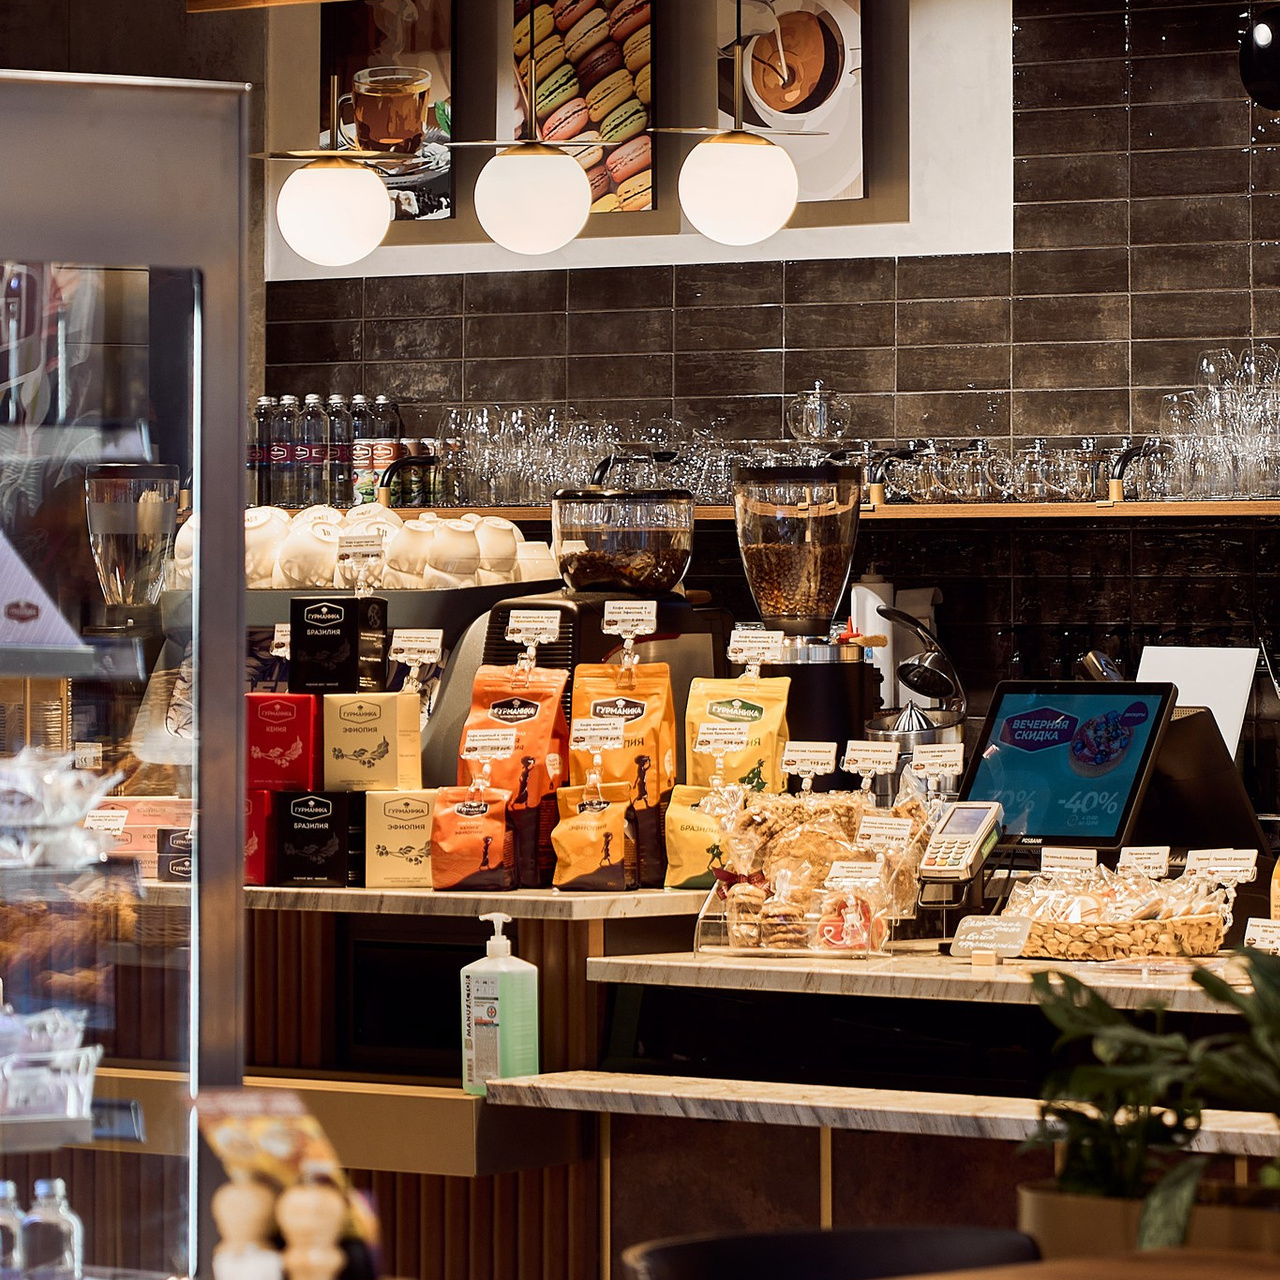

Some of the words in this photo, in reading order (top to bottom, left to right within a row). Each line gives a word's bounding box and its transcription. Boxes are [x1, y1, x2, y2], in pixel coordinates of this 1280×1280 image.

[307, 612, 340, 620] ГУРМАНИКА
[343, 710, 377, 718] ГУРМАНИКА
[596, 705, 642, 716] ГУРМАНИКА
[711, 705, 760, 718] ГУРМАНИКА
[1012, 719, 1070, 730] ВЕЧЕРНЯЯ
[1014, 730, 1059, 741] СКИДКА
[1058, 791, 1119, 815] -40%
[294, 806, 328, 814] ГУРМАНИКА
[388, 807, 425, 815] ГУРМАНИКА
[387, 823, 426, 831] ЭФИОПИЯ
